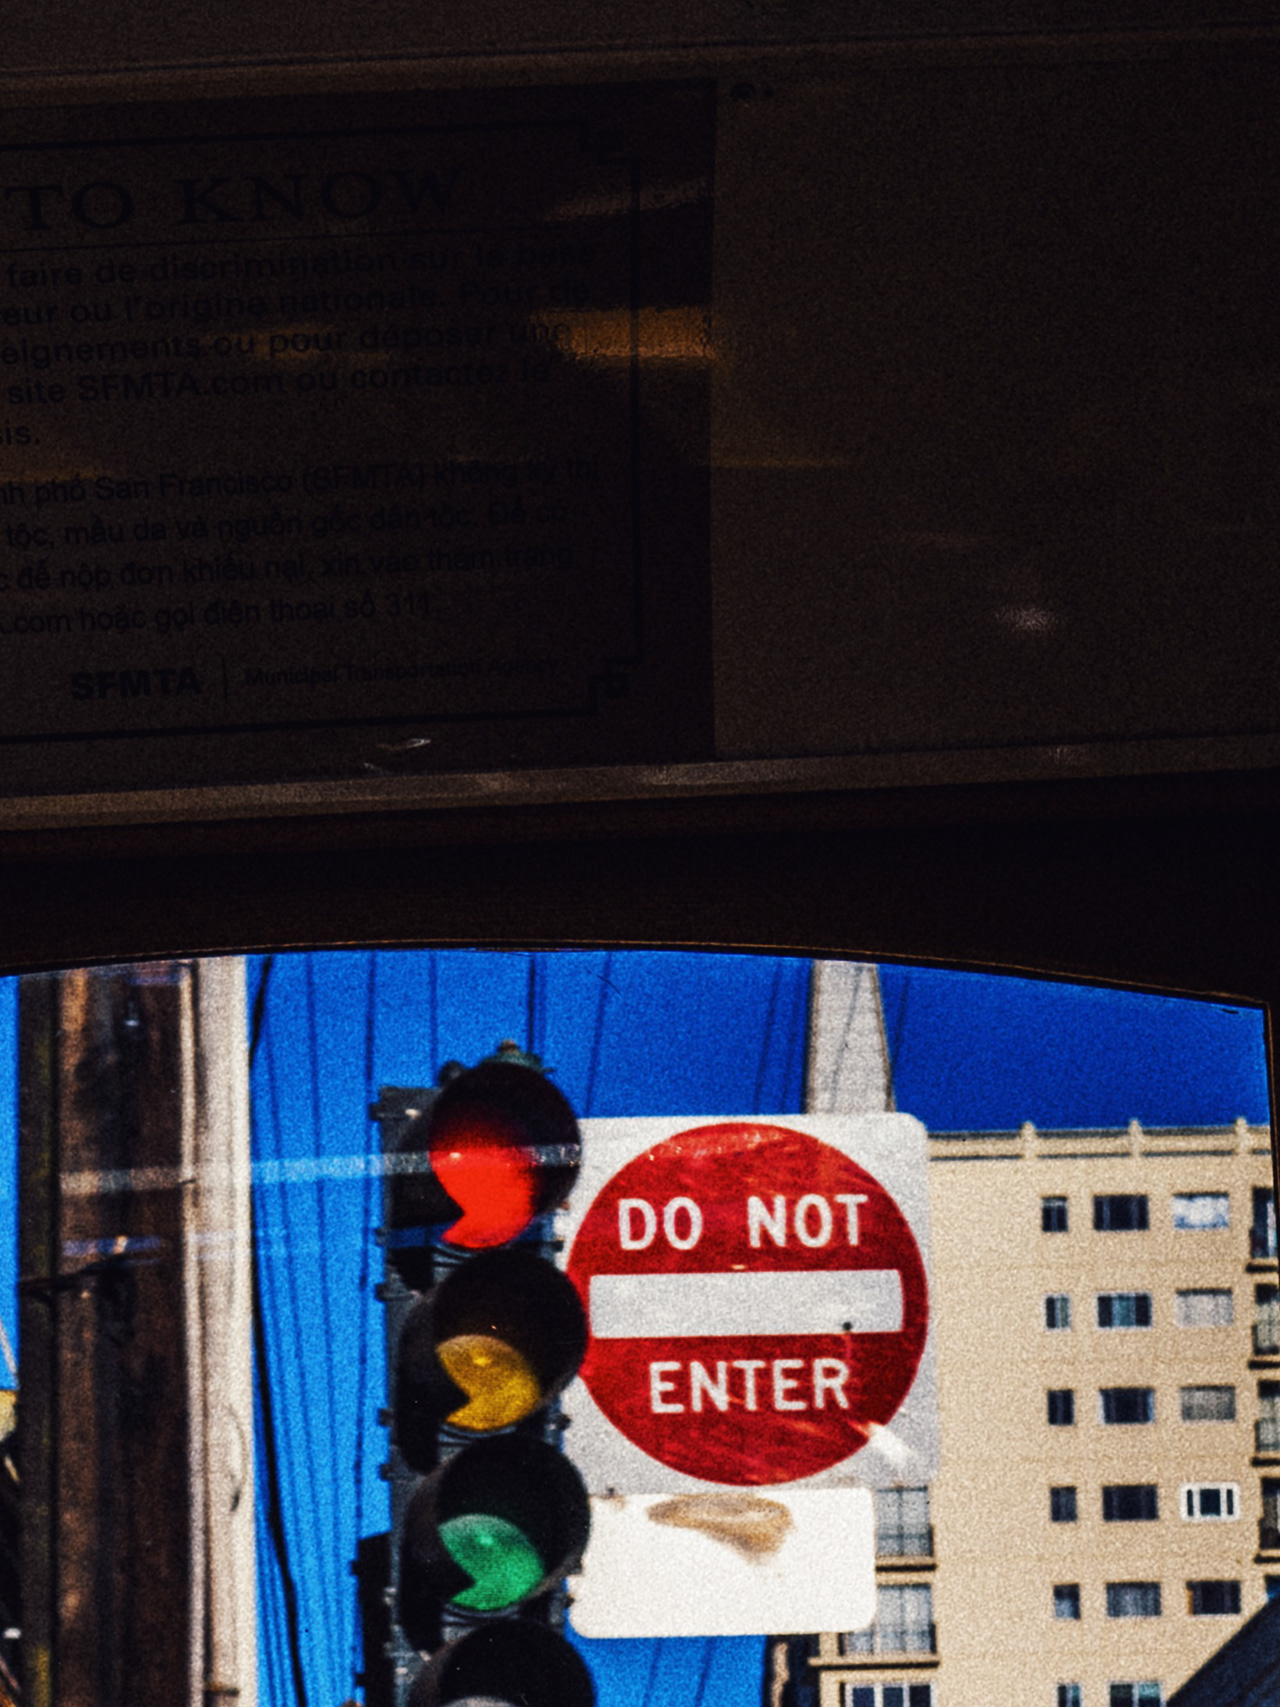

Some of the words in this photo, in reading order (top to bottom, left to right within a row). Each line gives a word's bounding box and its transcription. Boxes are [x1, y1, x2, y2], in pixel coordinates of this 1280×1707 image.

[5, 180, 134, 233] TO
[171, 167, 467, 225] KNOW
[5, 260, 83, 290] faire
[93, 257, 136, 286] de
[147, 245, 397, 284] discrimination
[407, 248, 460, 272] sur
[69, 303, 111, 326] ou
[278, 282, 447, 317] nationale.
[458, 278, 537, 308] Pour
[549, 276, 590, 304] de
[213, 334, 255, 357] ou
[270, 330, 347, 361] pour
[358, 317, 499, 357] déposer
[509, 319, 570, 343] une
[7, 376, 66, 406] site
[76, 366, 284, 402] SFMTA.com
[295, 369, 338, 392] ou
[349, 355, 509, 390] contactez
[93, 474, 151, 502] San
[158, 468, 293, 499] Francisco
[302, 462, 425, 499] (SFMTA)
[4, 522, 55, 555] tộc,
[132, 517, 168, 543] da
[174, 515, 209, 541] và
[59, 562, 112, 595] nộp
[320, 550, 362, 576] xin
[79, 603, 148, 637] hoặc
[154, 601, 195, 634] gọi
[268, 595, 336, 629] thoại
[383, 590, 442, 617] 311.
[69, 664, 204, 701] SFMTA
[244, 663, 339, 690] Municipal
[616, 1196, 704, 1252] DO
[746, 1193, 869, 1250] NOT
[648, 1357, 852, 1416] ENTER
